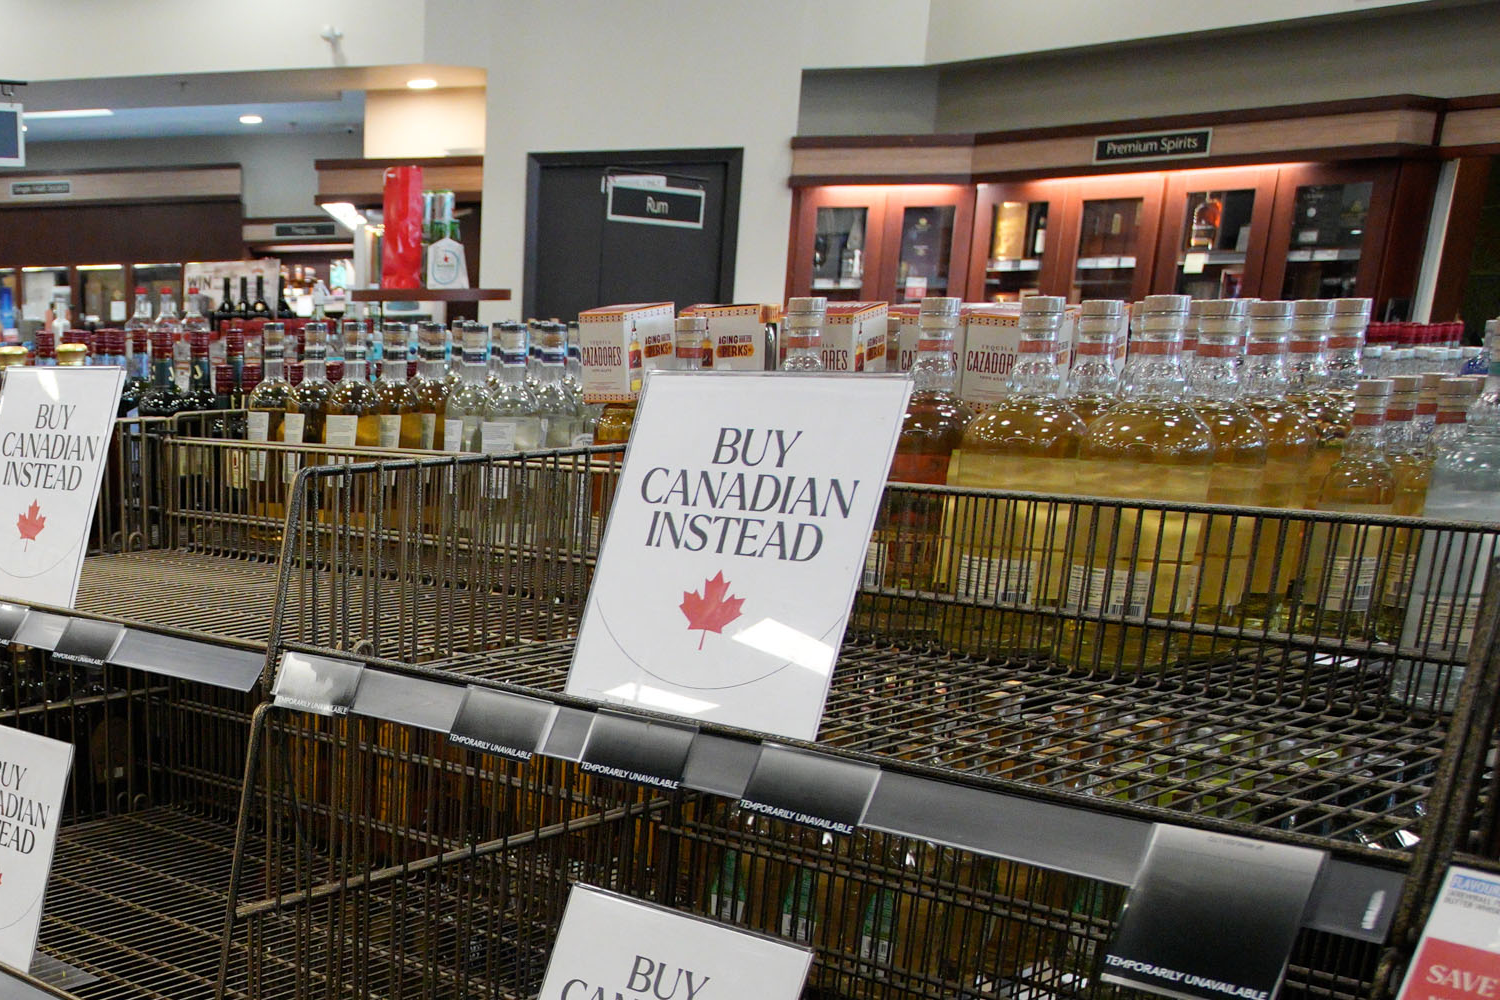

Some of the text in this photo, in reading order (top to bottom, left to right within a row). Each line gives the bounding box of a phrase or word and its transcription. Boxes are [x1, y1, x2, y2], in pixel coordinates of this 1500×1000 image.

[1106, 136, 1198, 155] Premium Spirits
[646, 196, 668, 214] Rum
[582, 346, 622, 367] CAZADORES
[35, 403, 77, 430] BUY
[2, 431, 100, 462] CANADIAN
[711, 427, 803, 468] BUY
[2, 460, 83, 491] INSTEAD
[641, 467, 860, 519] CANADIAN
[645, 510, 823, 562] INSTEAD
[275, 695, 348, 715] TEMPORARILY UNAVAILABLE
[449, 733, 533, 761] TEMPORARILY UNAVAILABLE
[581, 761, 680, 790] TEMPORARILY UNAVAILABLE
[740, 799, 854, 835] TEMPORARILY UNAVAILABLE
[1105, 954, 1186, 982] TEMPORARILY
[1426, 964, 1499, 998] SAVE
